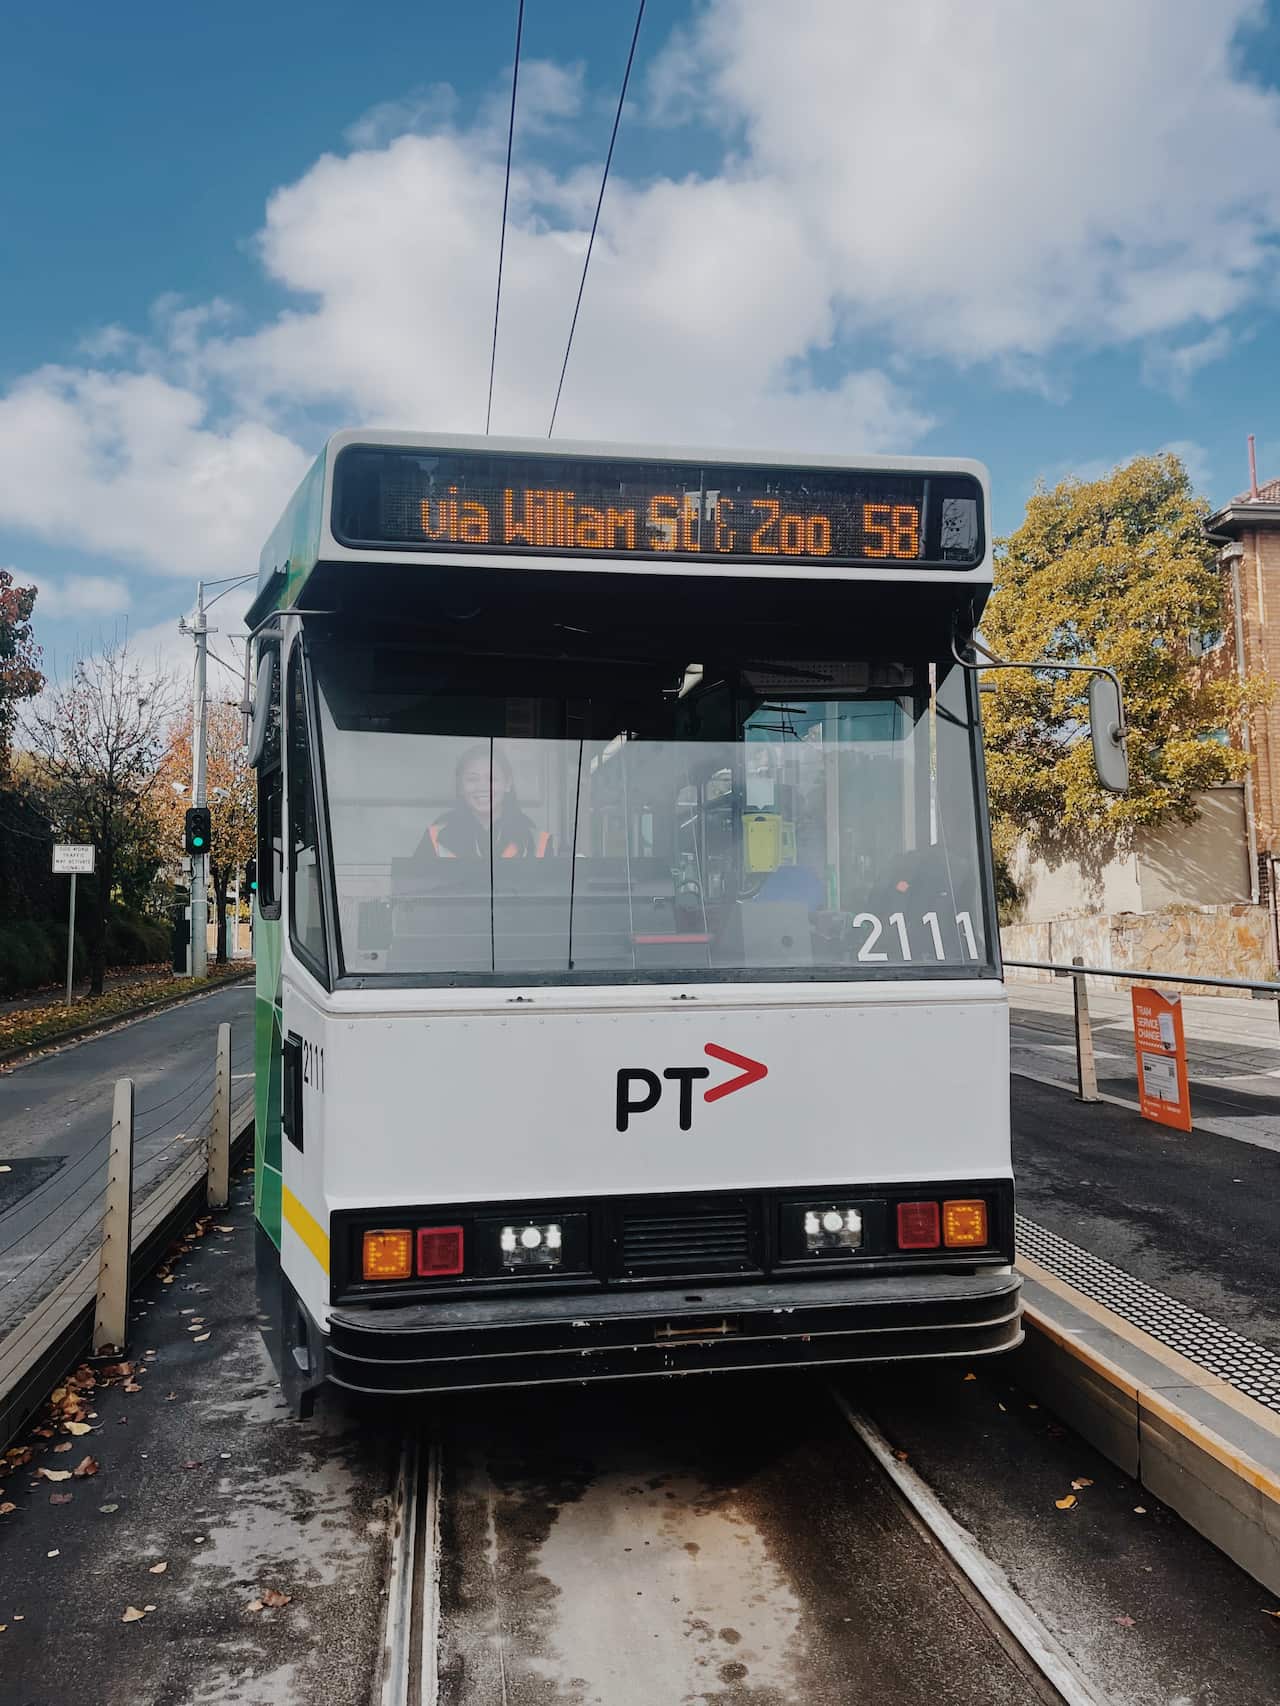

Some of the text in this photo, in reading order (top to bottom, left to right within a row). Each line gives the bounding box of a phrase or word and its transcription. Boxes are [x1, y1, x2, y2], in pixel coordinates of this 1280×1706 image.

[504, 488, 635, 549] William
[752, 500, 831, 555] Zoo
[863, 504, 919, 558] 58
[853, 912, 979, 961] 2111
[1136, 1005, 1152, 1016] TRAM
[1136, 1017, 1160, 1030] SERVICE
[303, 1039, 324, 1094] 2111
